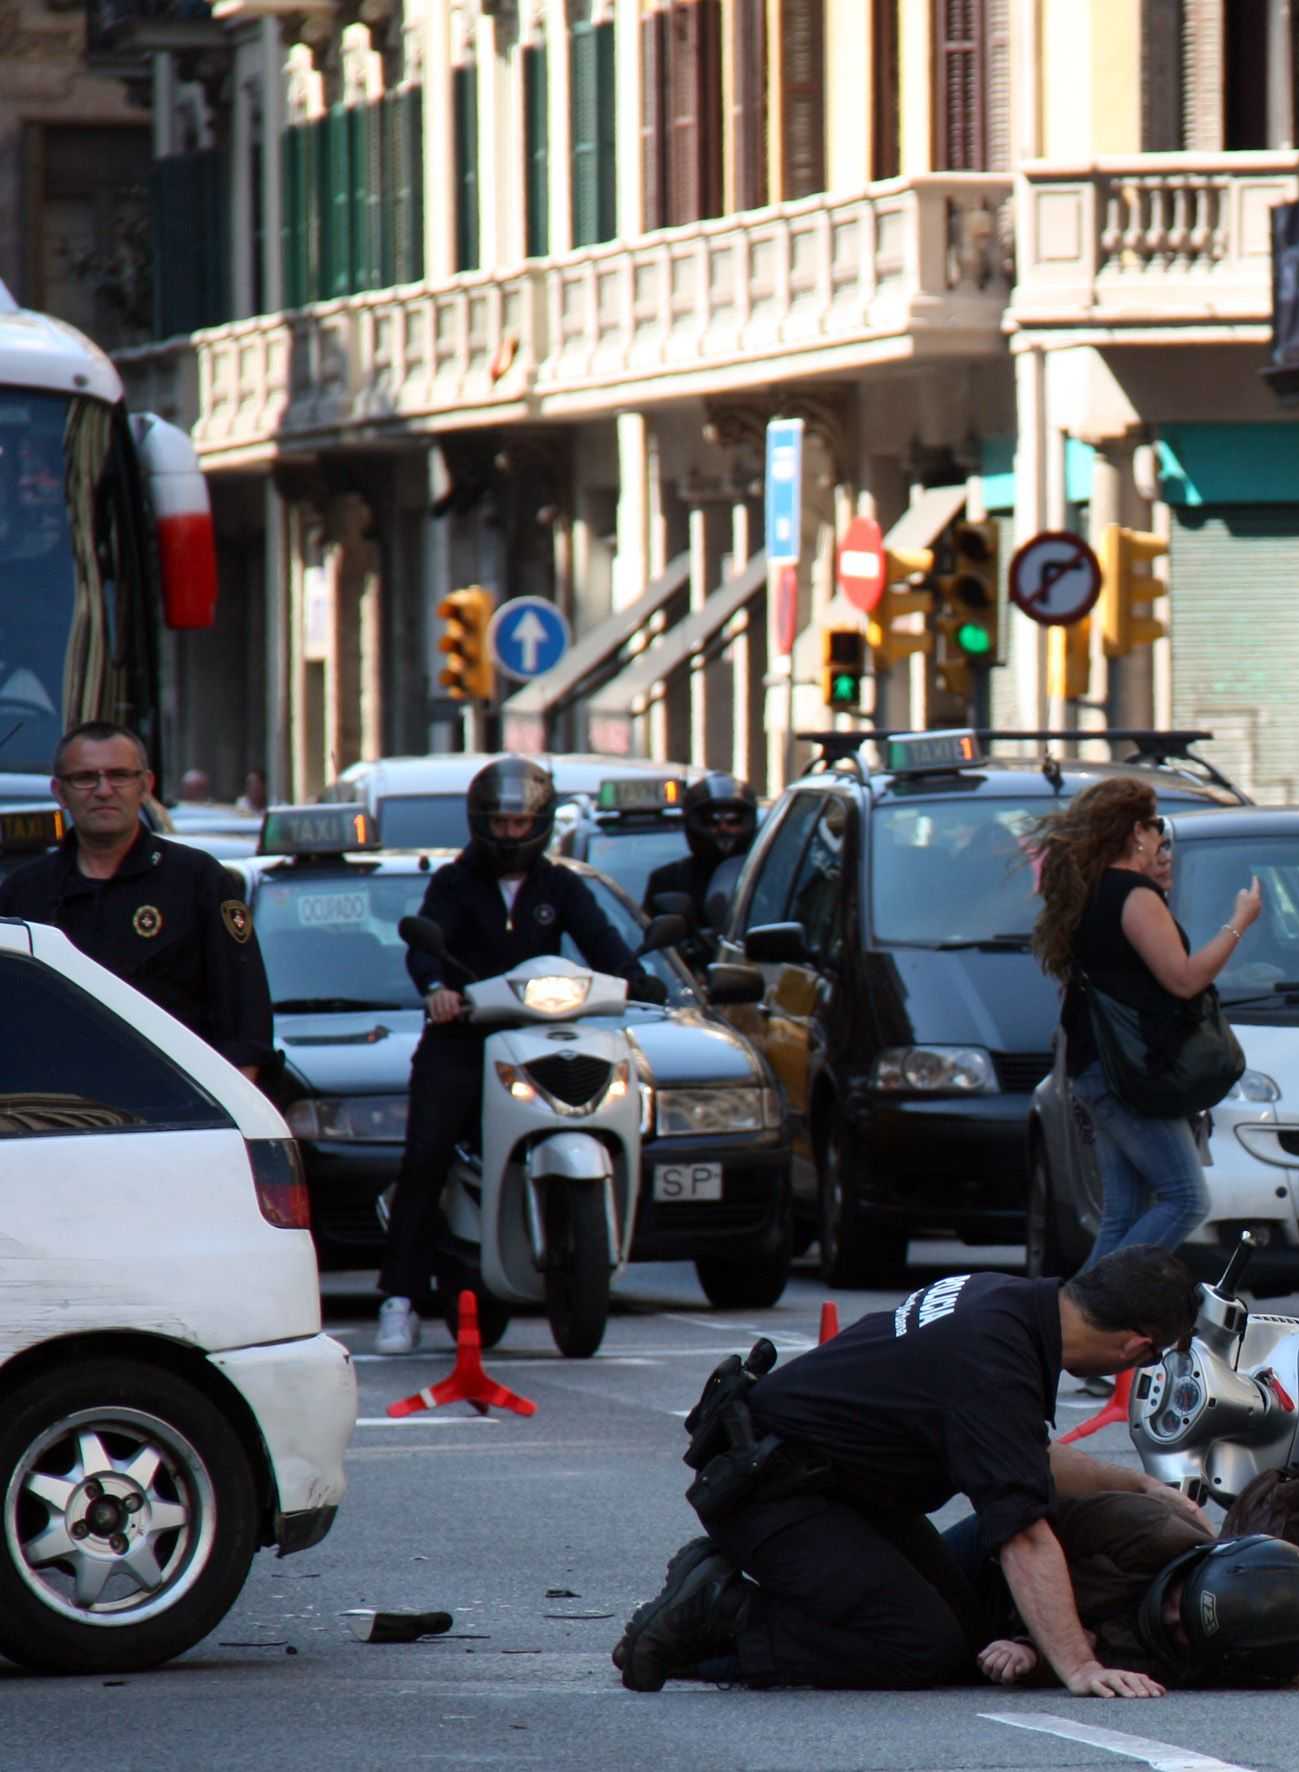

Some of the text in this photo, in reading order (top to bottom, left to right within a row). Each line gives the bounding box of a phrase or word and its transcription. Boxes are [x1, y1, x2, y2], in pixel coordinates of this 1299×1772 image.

[290, 813, 367, 845] TAXI 1
[918, 1274, 972, 1329] POLICIA
